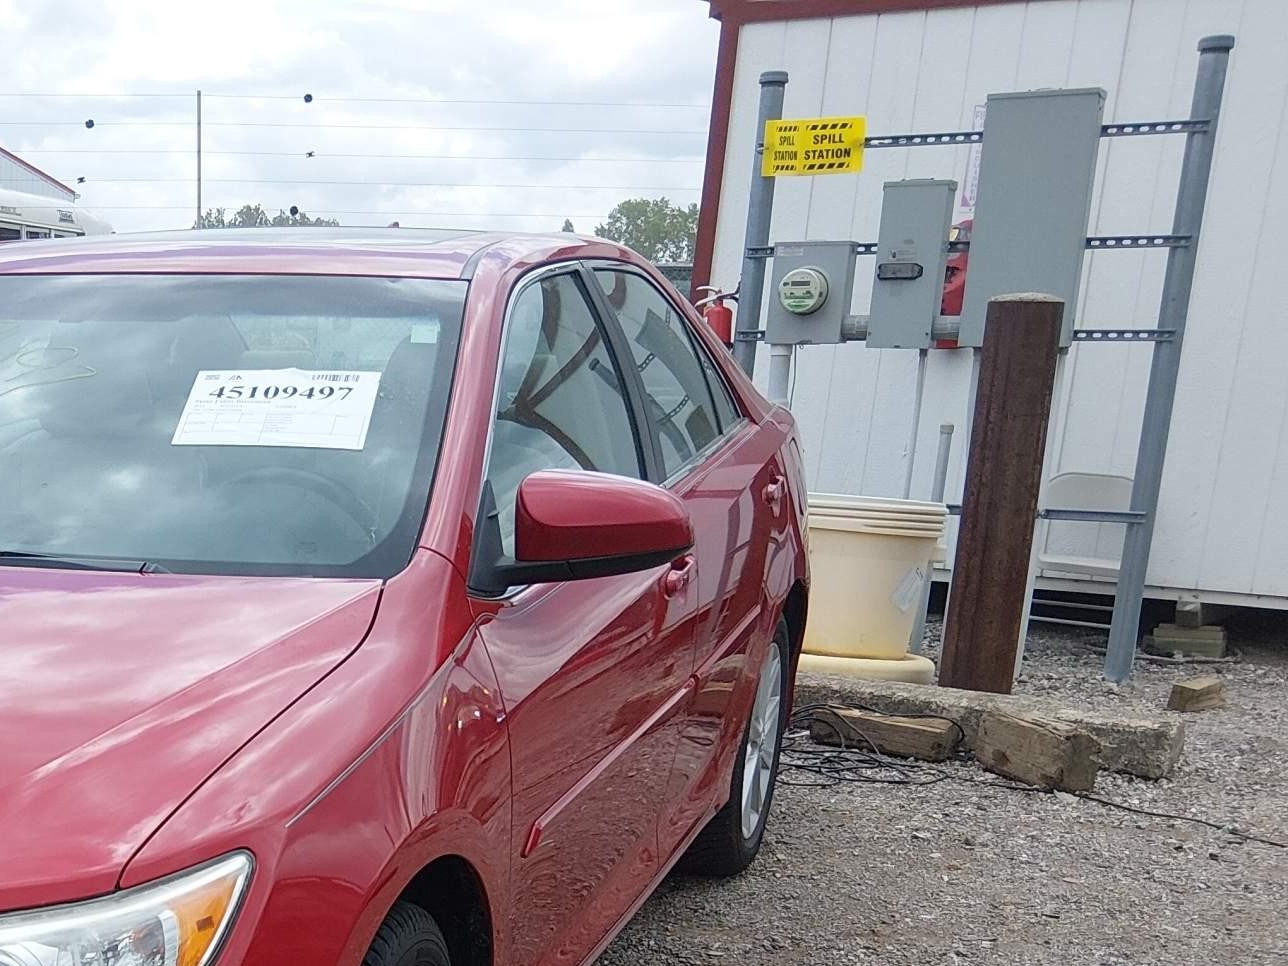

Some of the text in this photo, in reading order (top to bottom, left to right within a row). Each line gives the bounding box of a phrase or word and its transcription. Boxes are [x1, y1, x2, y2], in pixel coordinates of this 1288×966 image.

[778, 135, 795, 146] SPILL
[812, 133, 845, 145] SPILL
[773, 150, 798, 161] STATION
[803, 147, 852, 161] STATION
[208, 385, 354, 401] 45109497
